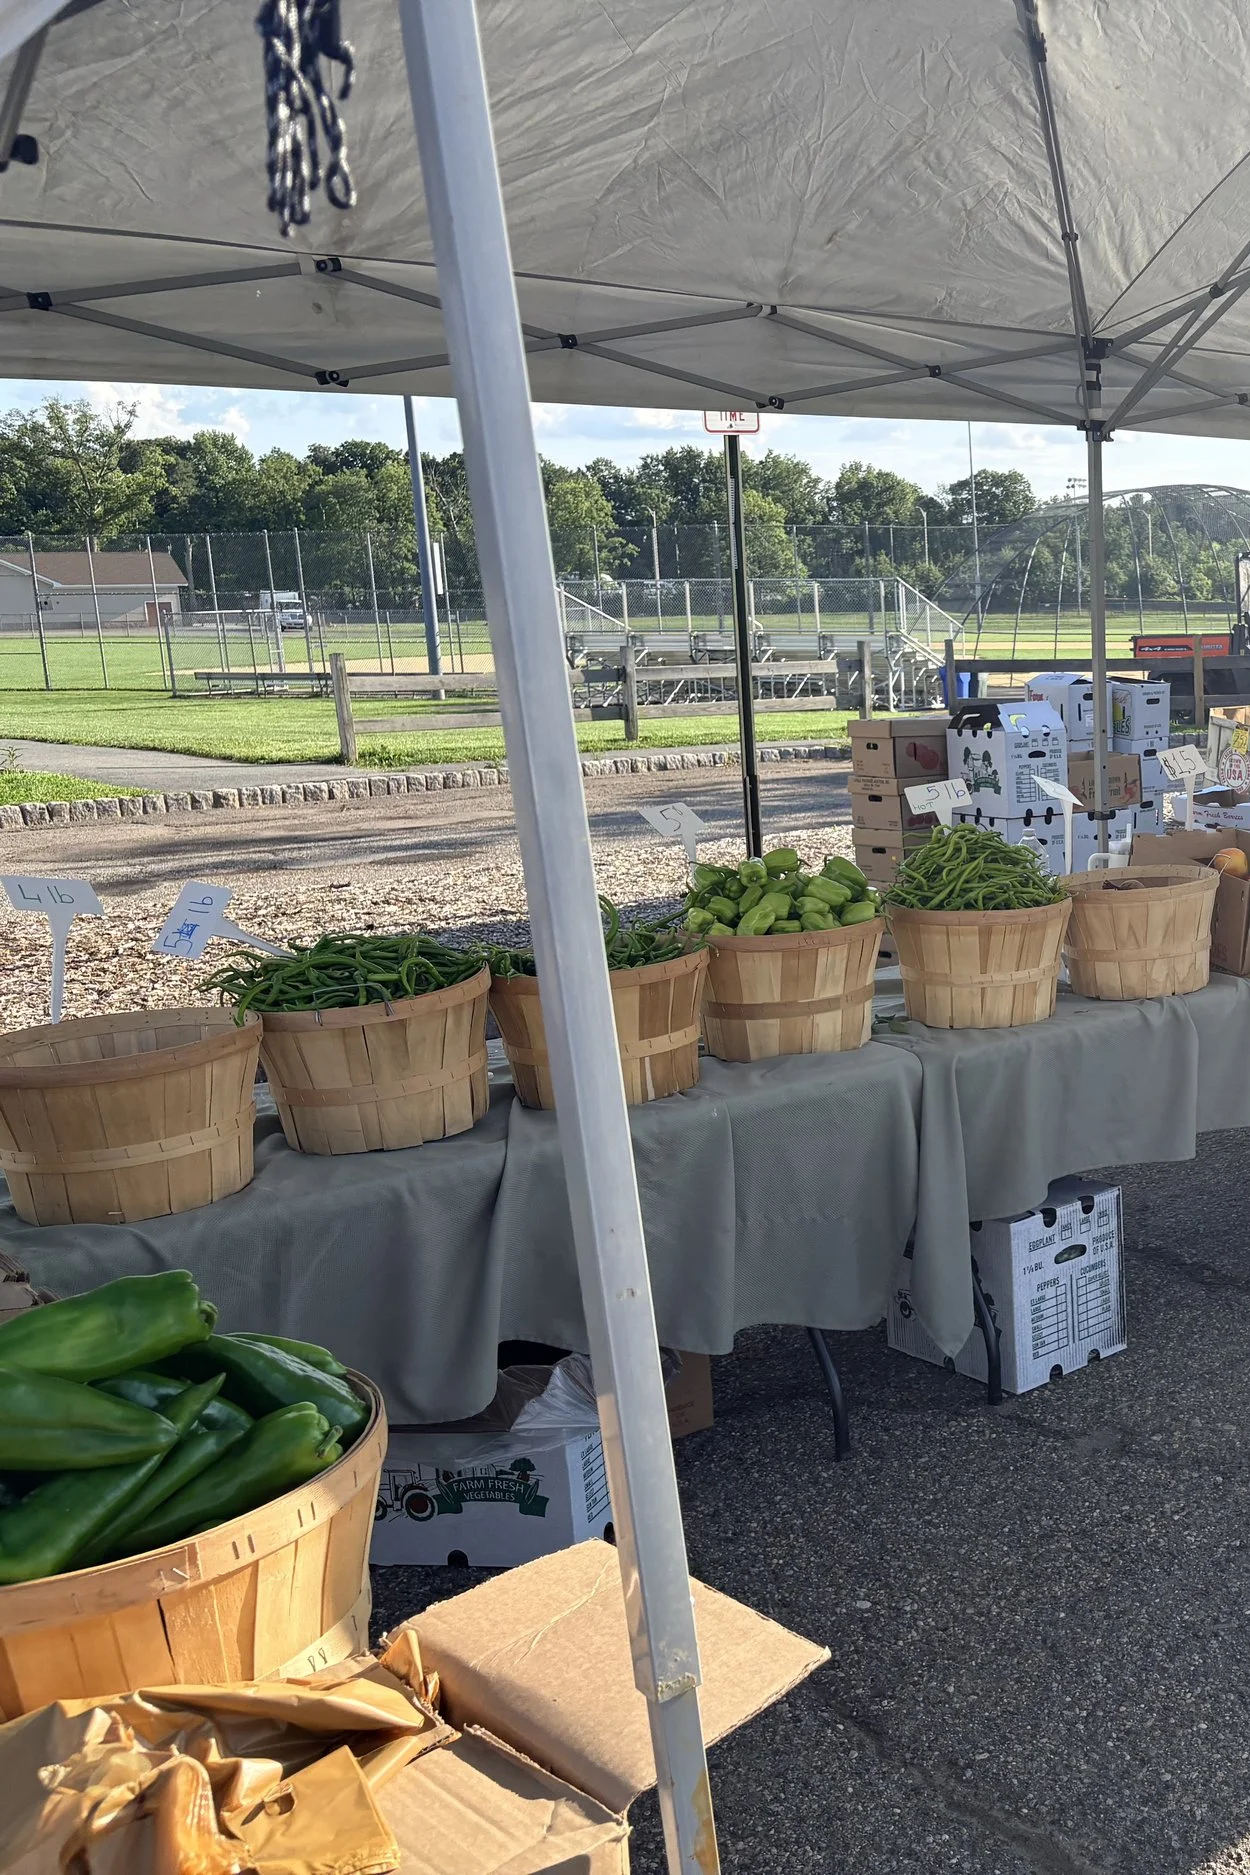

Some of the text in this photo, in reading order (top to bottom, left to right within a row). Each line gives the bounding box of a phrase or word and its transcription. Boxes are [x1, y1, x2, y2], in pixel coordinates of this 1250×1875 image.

[1226, 768, 1243, 781] USA
[926, 785, 940, 801] 5
[913, 801, 934, 811] HOT
[1204, 810, 1221, 819] Fresh
[1222, 812, 1244, 821] Berries
[1028, 1233, 1056, 1251] EGGPLANT
[1092, 1230, 1115, 1245] PRODUCE
[1092, 1246, 1099, 1255] OF
[1080, 1259, 1107, 1275] CUCUMBERS
[1036, 1276, 1060, 1292] PEPPERS
[1030, 1305, 1042, 1314] LARGE
[452, 1479, 524, 1493] FARM FRESH
[463, 1492, 516, 1501] VEGETABLES
